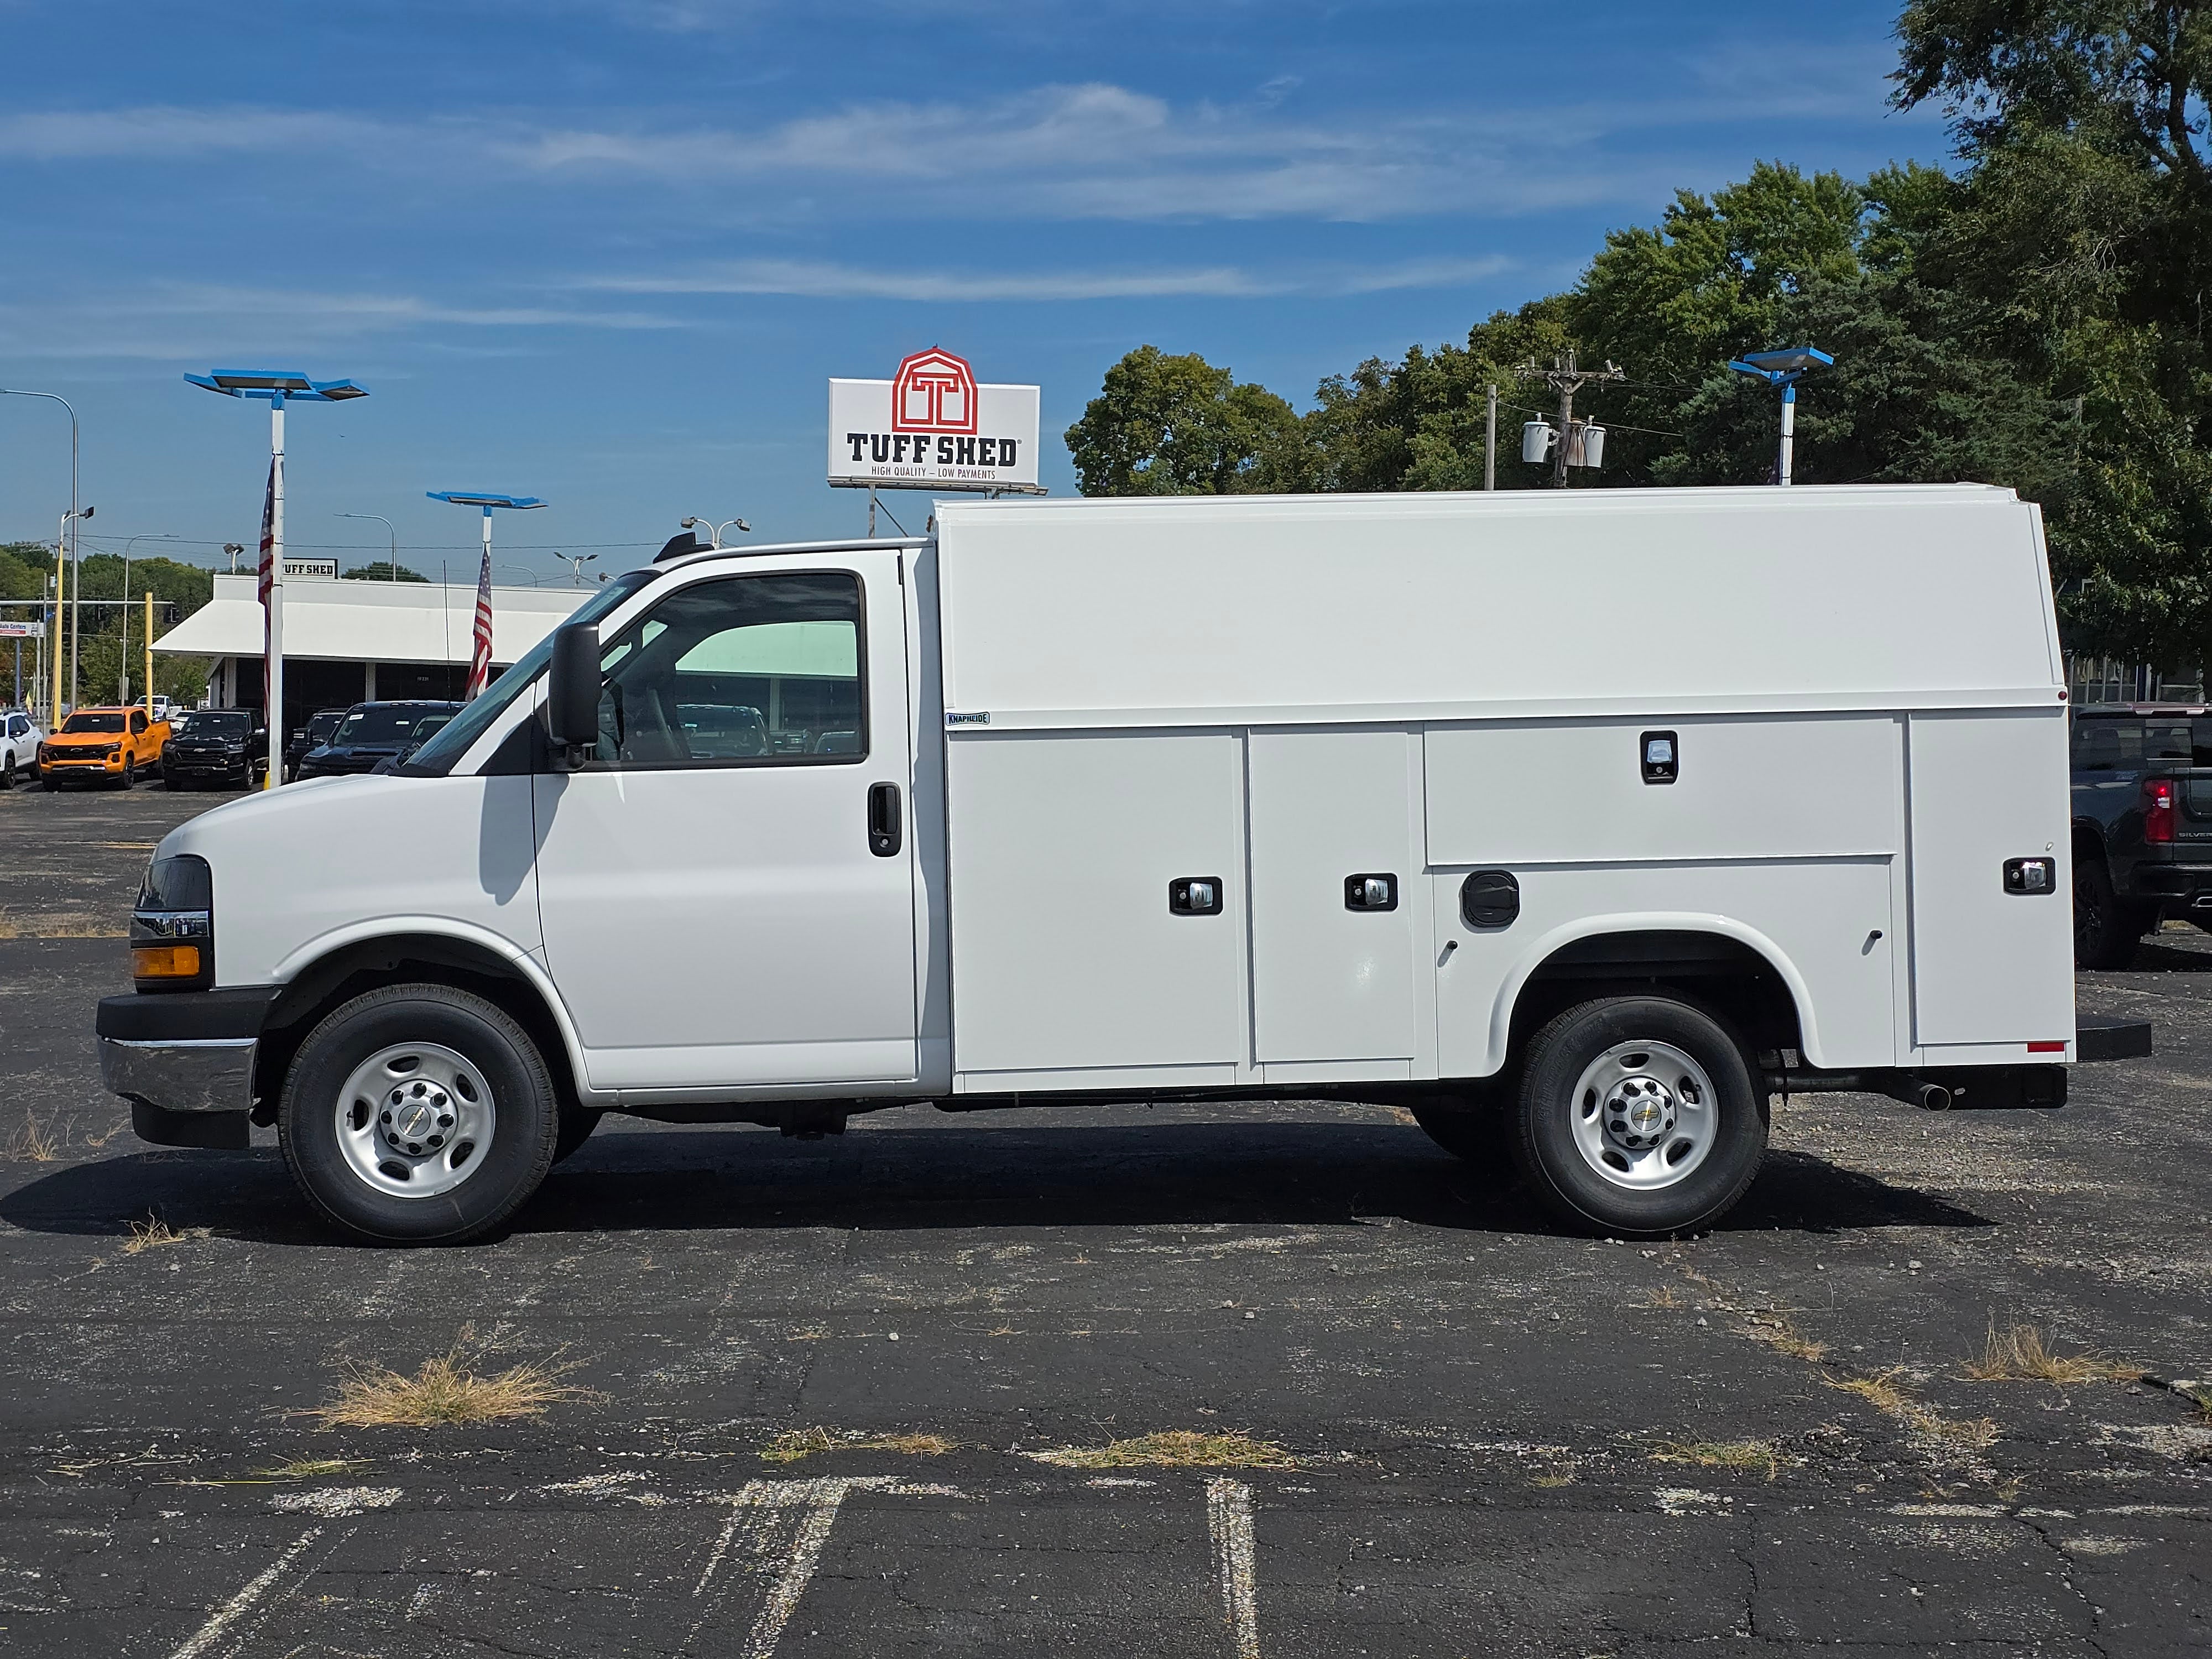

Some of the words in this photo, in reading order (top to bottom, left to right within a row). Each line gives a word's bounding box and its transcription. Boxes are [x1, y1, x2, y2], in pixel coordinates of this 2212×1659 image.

[847, 433, 931, 463] TUFF
[872, 466, 891, 476] HIGH
[894, 467, 926, 477] QUALITY
[938, 468, 954, 477] LOW
[958, 468, 996, 480] PAYMENTS
[283, 565, 304, 573] UFF
[306, 565, 333, 574] SHED
